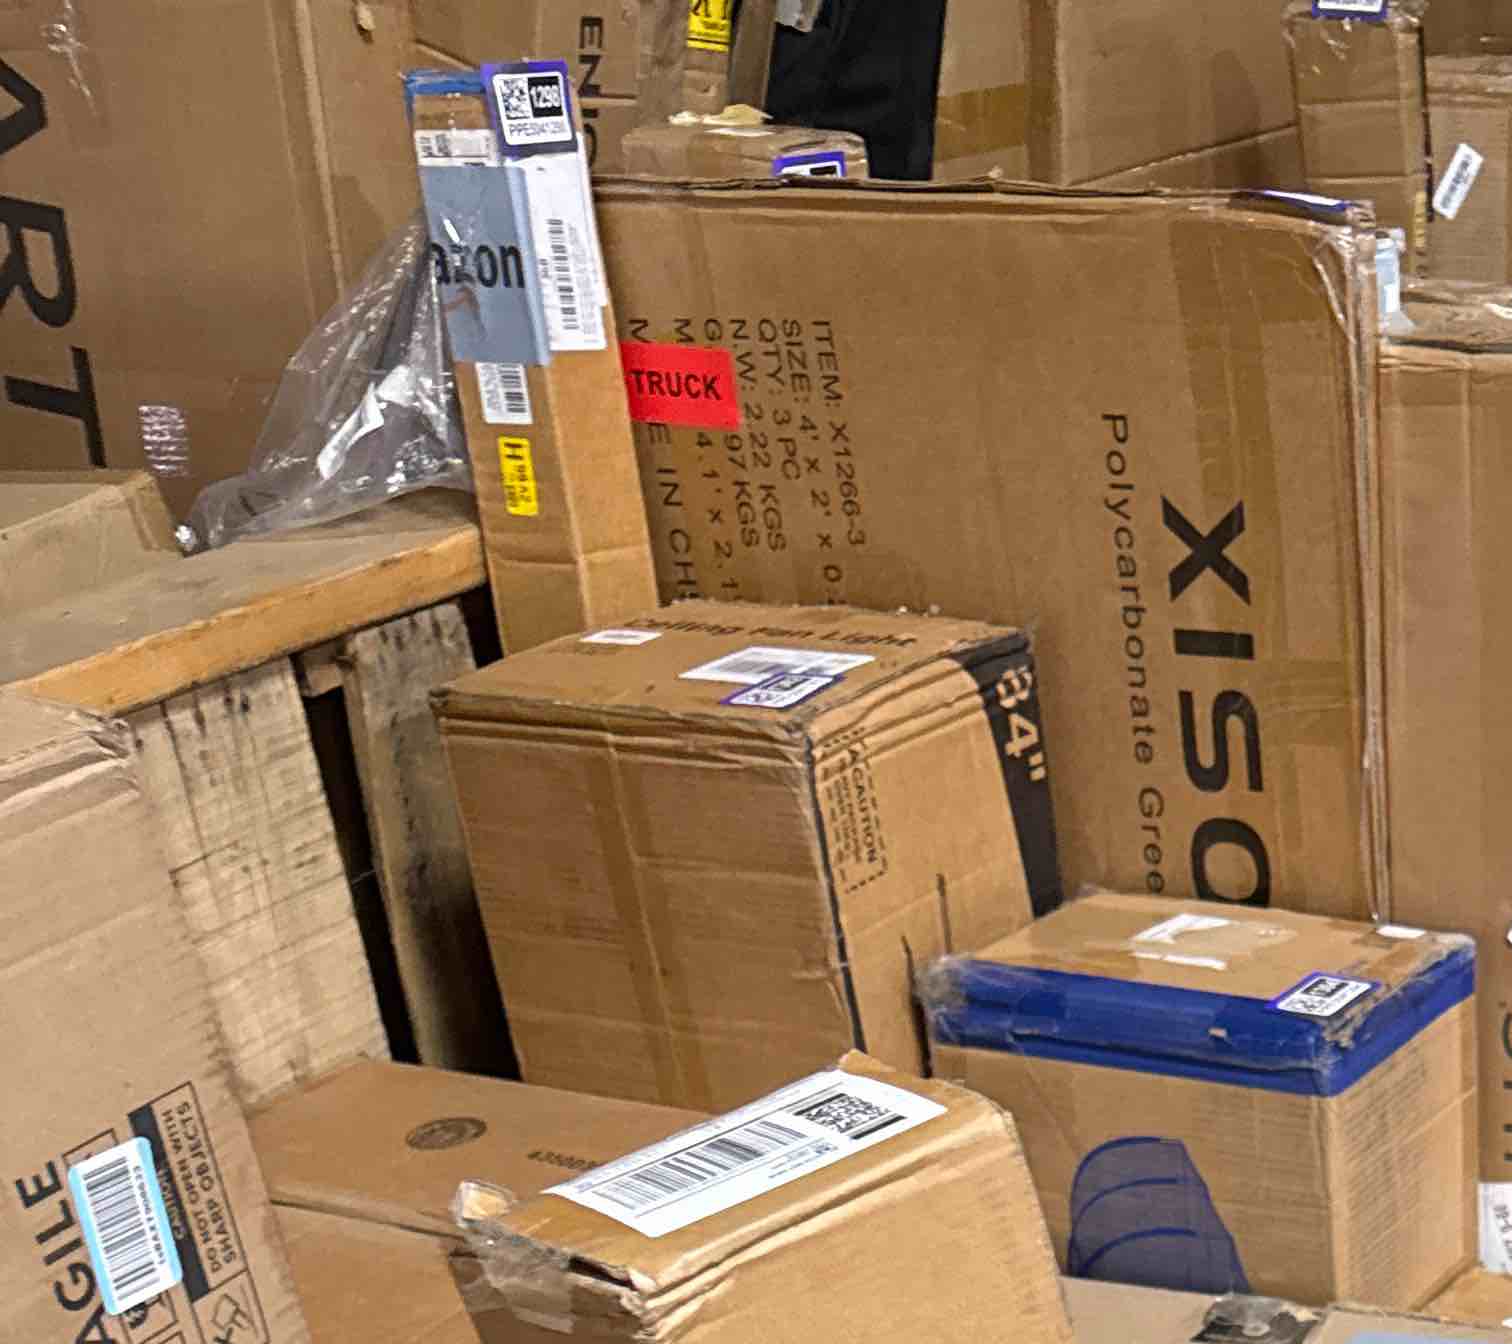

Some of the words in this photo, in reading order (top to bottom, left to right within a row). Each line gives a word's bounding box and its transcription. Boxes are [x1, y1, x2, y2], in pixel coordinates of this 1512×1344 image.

[629, 370, 722, 401] TRUCK
[758, 318, 786, 396] QTY:
[782, 319, 811, 402] SIZE:
[812, 319, 843, 408] ITEM:
[772, 408, 793, 426] 3
[656, 467, 683, 507] IN
[777, 436, 801, 481] PC
[733, 480, 760, 548] KGS
[759, 483, 787, 552] KGS
[1101, 412, 1157, 765] Polycarbonate
[850, 766, 879, 864] CAUTION
